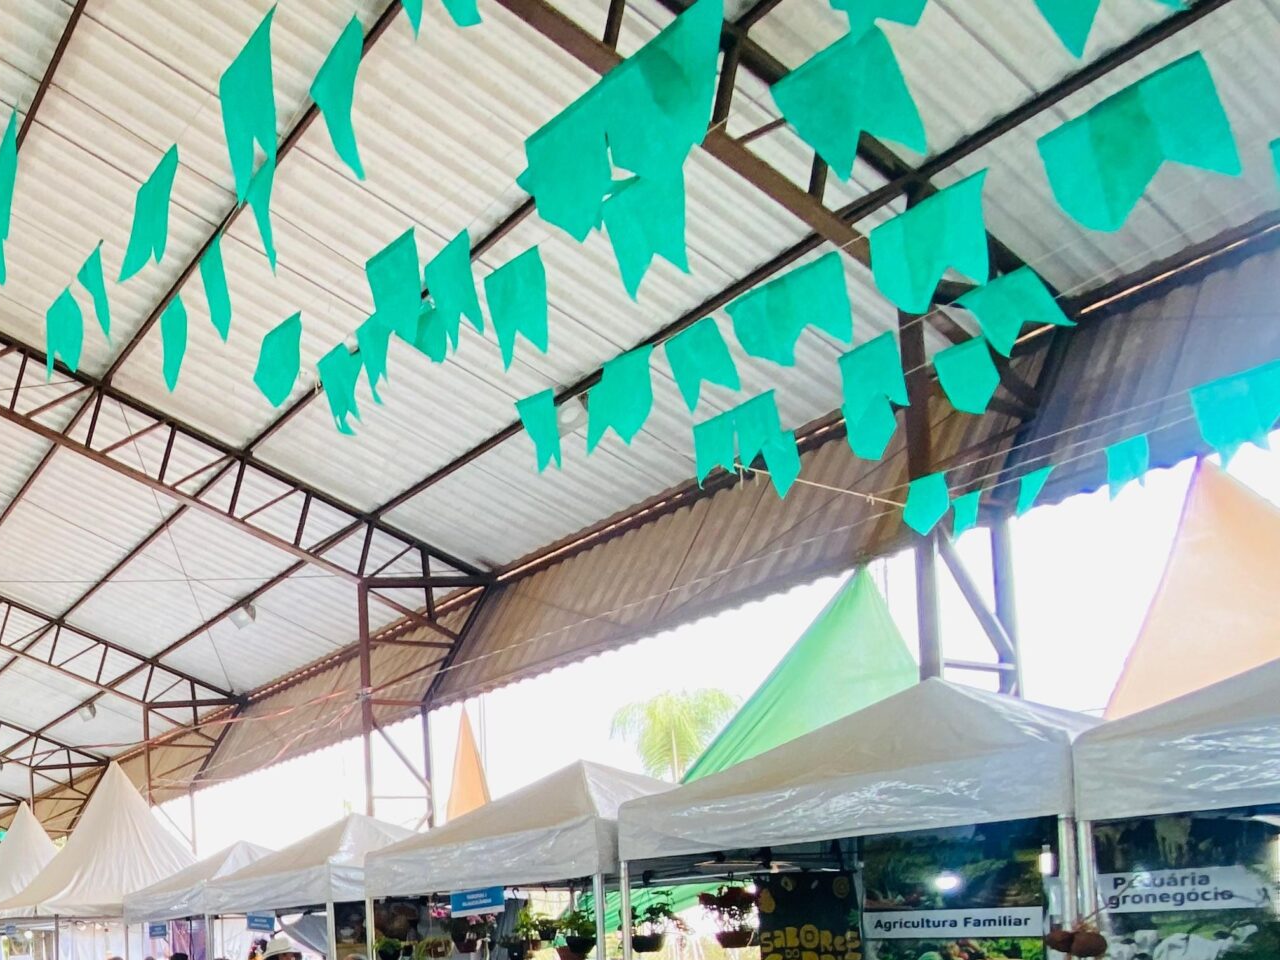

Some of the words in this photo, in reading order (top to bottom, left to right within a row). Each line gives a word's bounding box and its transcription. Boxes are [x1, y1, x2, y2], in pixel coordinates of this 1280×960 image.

[1113, 872, 1210, 891] Puária
[1108, 887, 1234, 909] gronegócio
[874, 918, 958, 932] Agricultura
[963, 915, 1031, 929] Familiar
